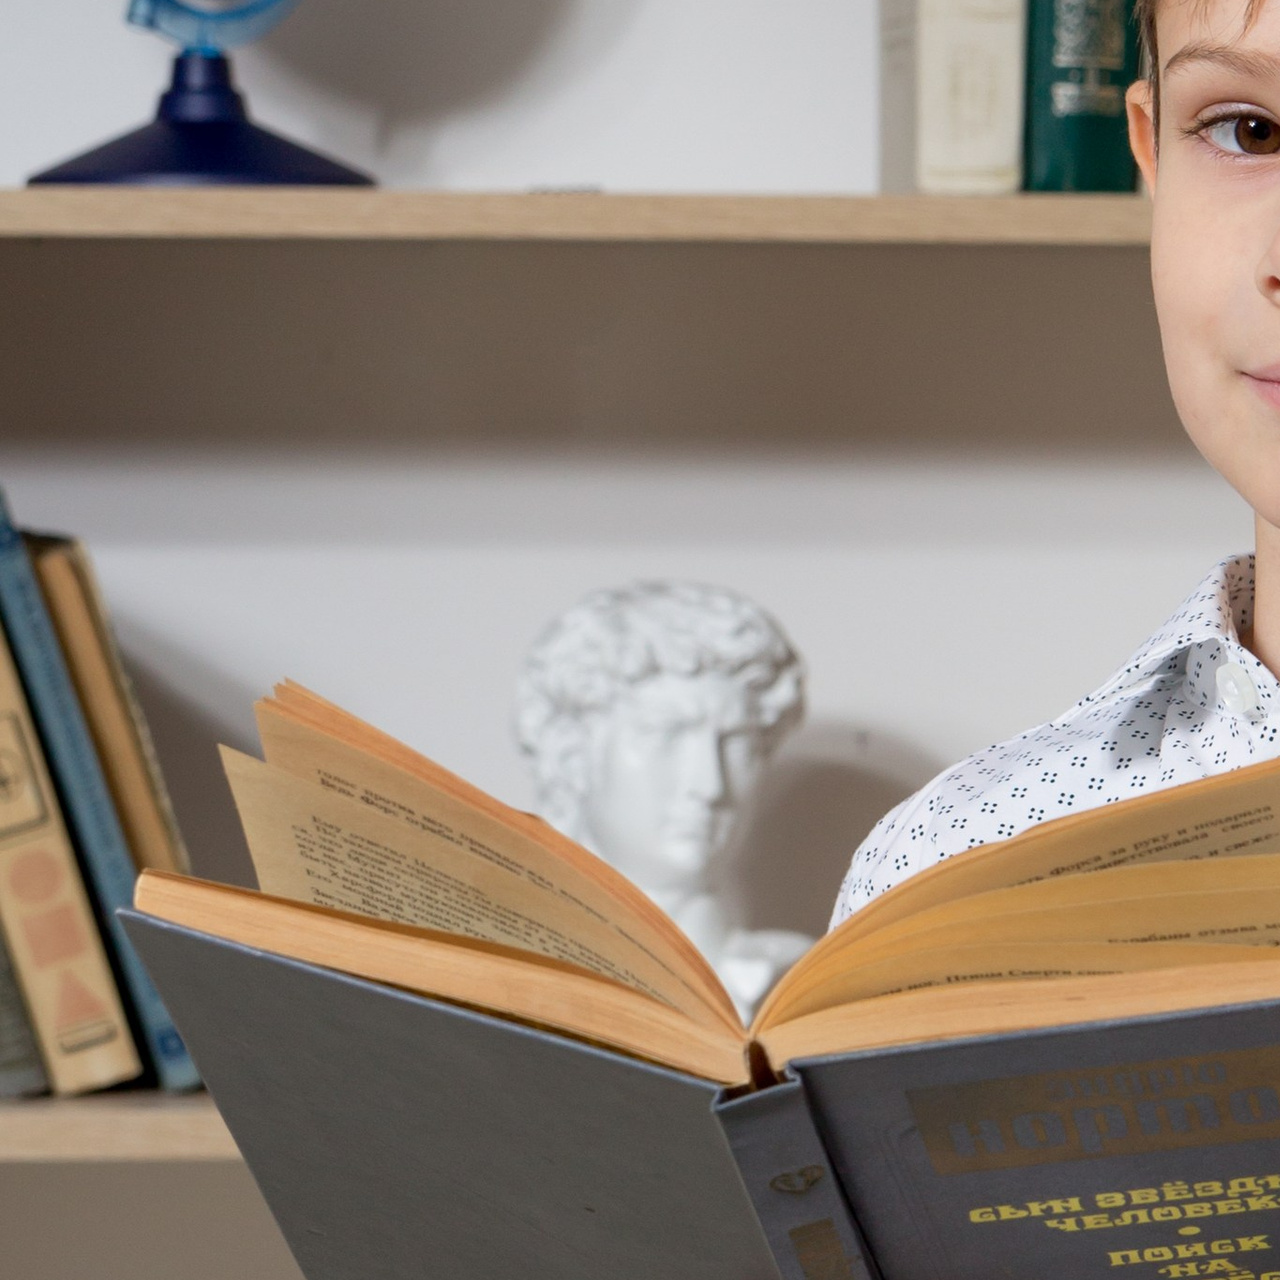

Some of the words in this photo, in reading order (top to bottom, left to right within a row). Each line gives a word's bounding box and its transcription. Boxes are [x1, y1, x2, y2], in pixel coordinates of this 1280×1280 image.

[968, 1196, 1085, 1224] СЫН
[1106, 1234, 1274, 1267] ПОИСК
[1157, 1257, 1245, 1279] НА
